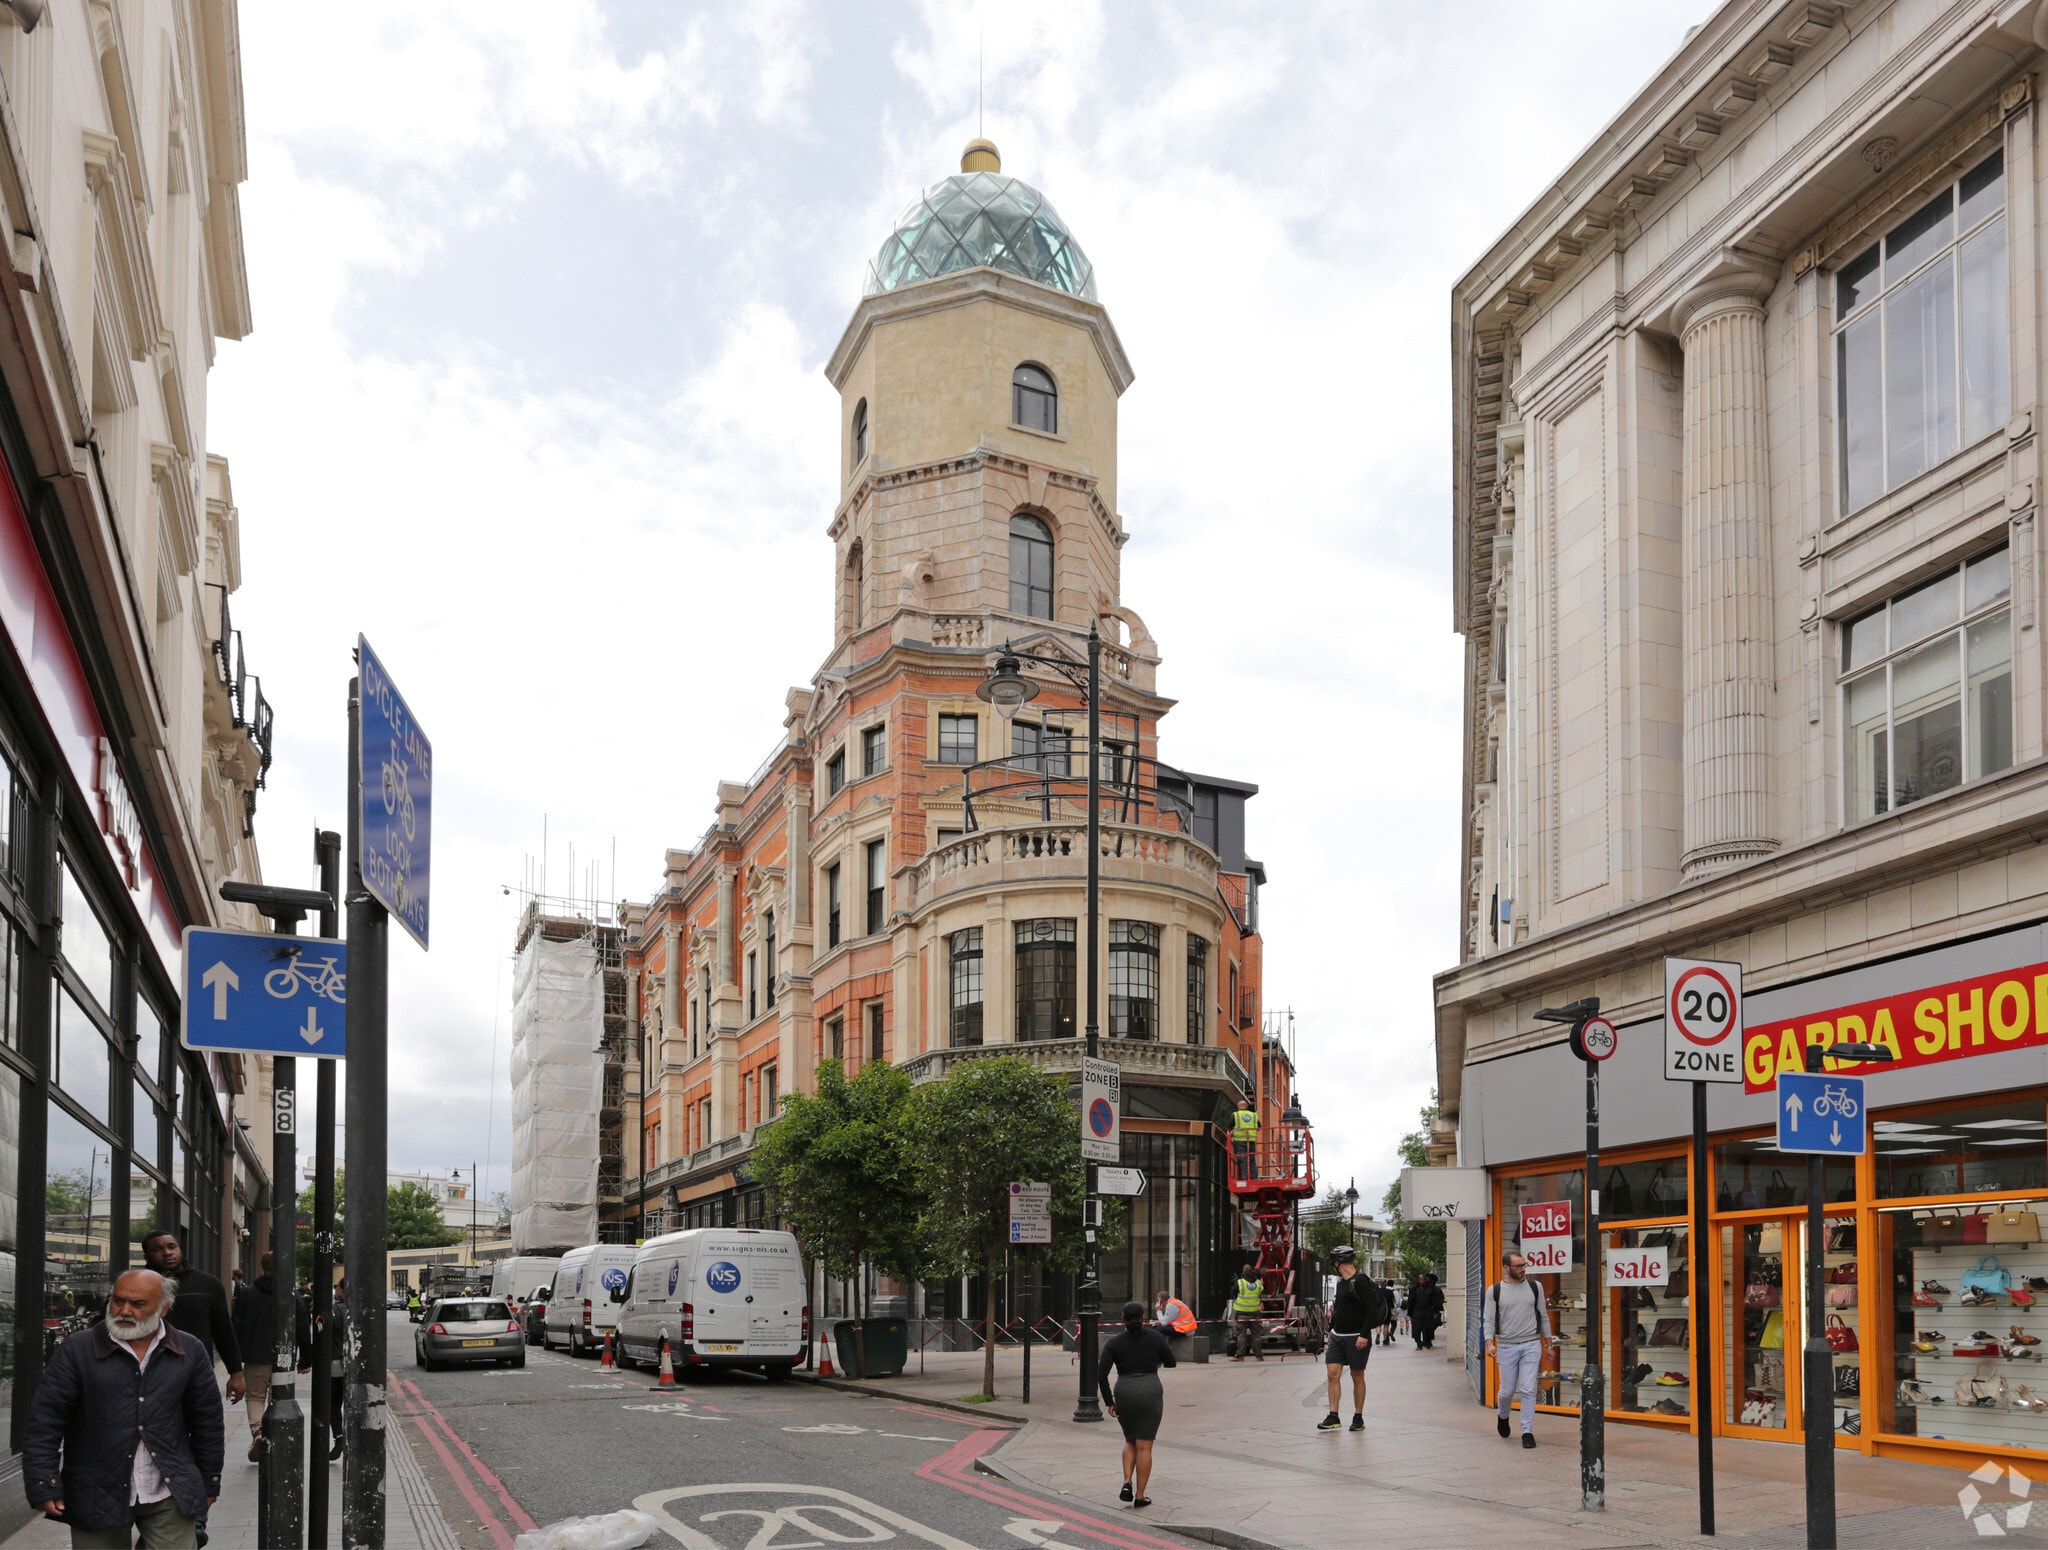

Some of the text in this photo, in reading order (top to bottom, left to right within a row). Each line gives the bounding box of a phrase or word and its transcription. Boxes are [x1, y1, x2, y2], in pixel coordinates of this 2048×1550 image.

[366, 661, 429, 781] CYCLE LANE
[386, 824, 411, 880] LOOK
[369, 846, 424, 932] BOTH WAYS
[1683, 990, 1727, 1023] 20
[1744, 1007, 1903, 1085] GARDA
[1085, 1059, 1118, 1075] Controlled
[1674, 1051, 1735, 1073] ZONE
[1085, 1071, 1117, 1088] ZONE B
[1525, 1208, 1567, 1234] sale
[709, 1245, 789, 1253] www.signs-nis.co.uk
[1526, 1244, 1567, 1268] sale
[1614, 1254, 1661, 1280] sale
[699, 1505, 897, 1550] 20
